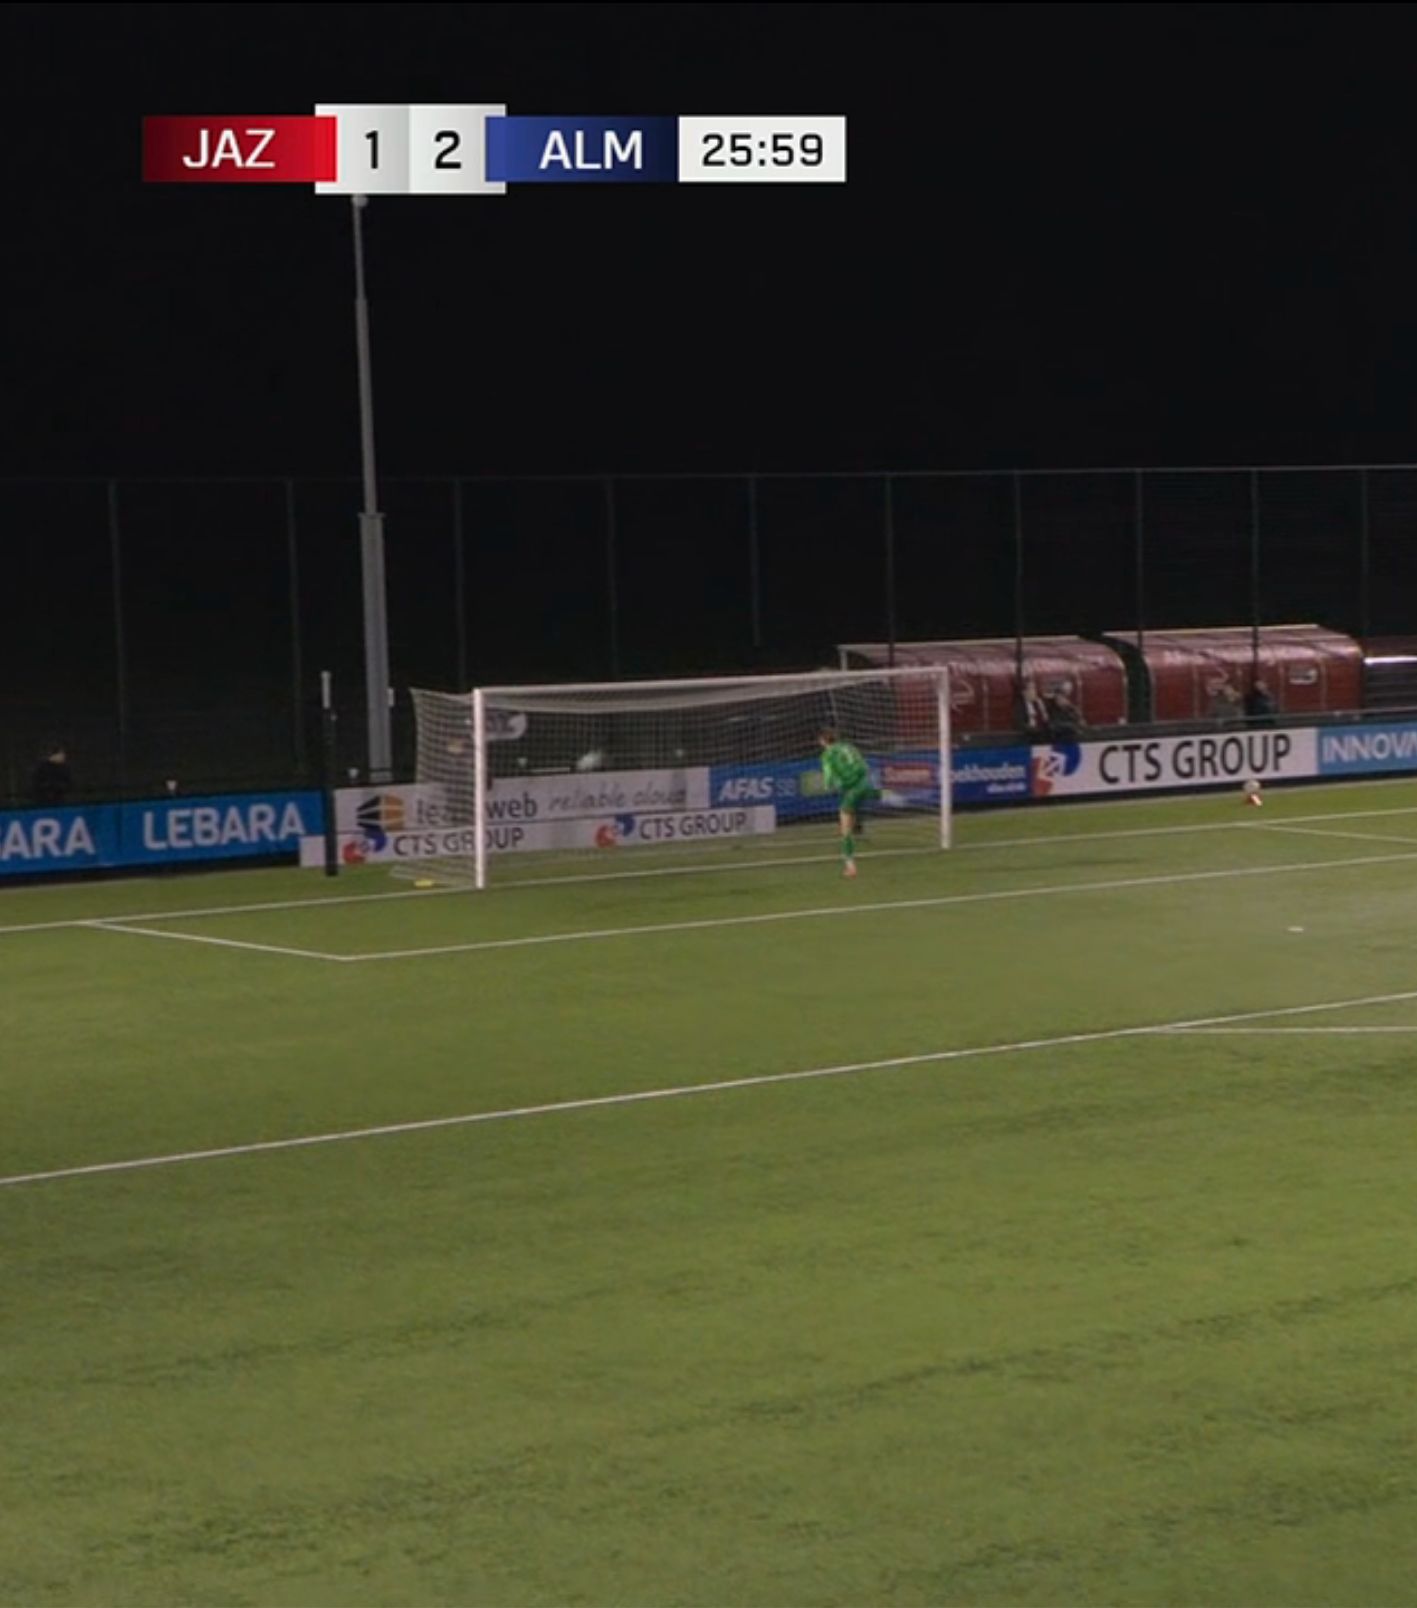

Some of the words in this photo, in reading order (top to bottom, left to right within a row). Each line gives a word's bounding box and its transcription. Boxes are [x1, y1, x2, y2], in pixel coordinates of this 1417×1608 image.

[1098, 742, 1162, 784] CTS
[1171, 733, 1291, 779] GROUP
[143, 802, 306, 851] LEBARA
[394, 830, 436, 857] CTS
[640, 817, 674, 840] CTS
[679, 811, 747, 837] GROUP
